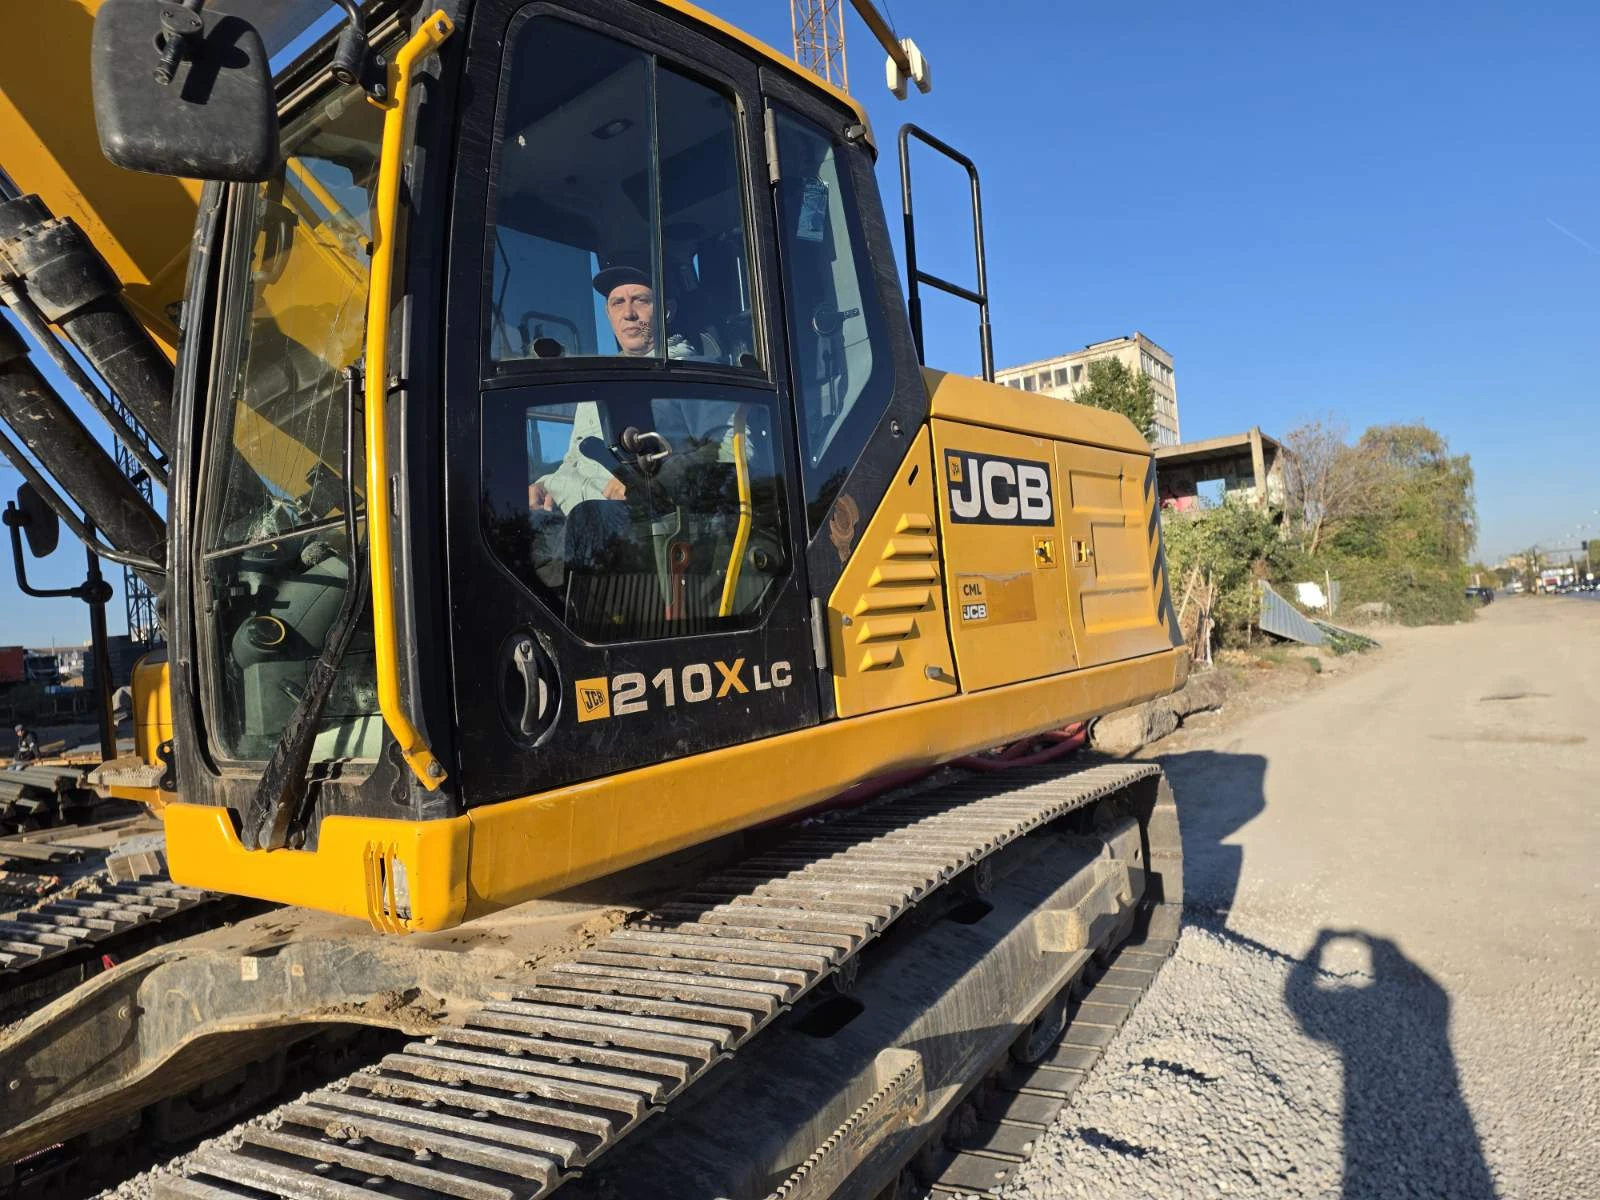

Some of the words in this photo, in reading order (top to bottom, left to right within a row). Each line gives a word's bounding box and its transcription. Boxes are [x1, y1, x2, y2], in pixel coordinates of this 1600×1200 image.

[951, 458, 1052, 521] JCB
[963, 583, 982, 596] CML
[962, 604, 987, 619] JCB
[583, 689, 605, 711] JCB
